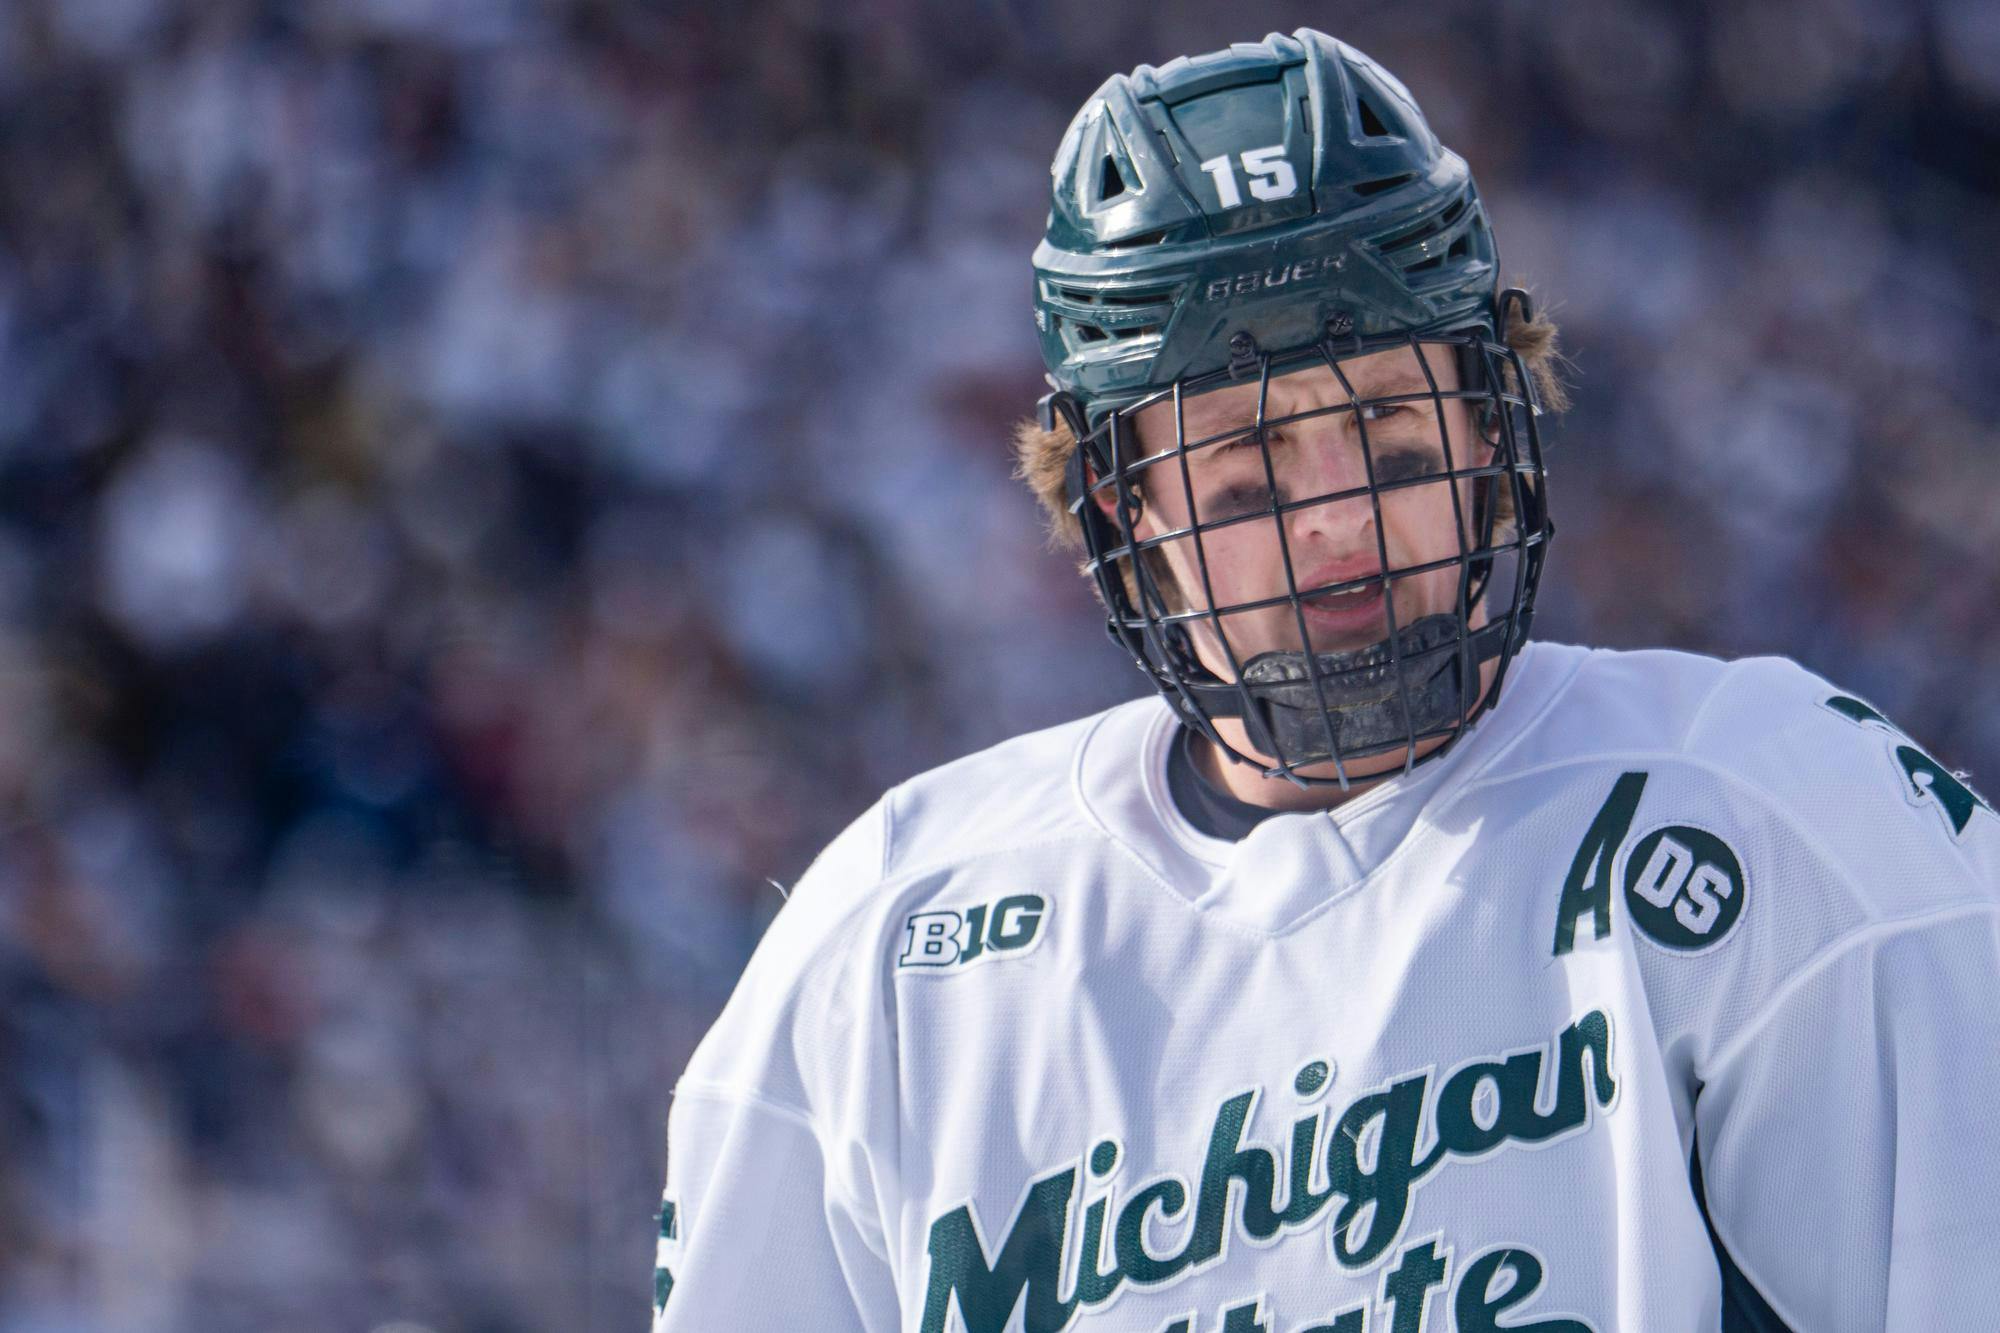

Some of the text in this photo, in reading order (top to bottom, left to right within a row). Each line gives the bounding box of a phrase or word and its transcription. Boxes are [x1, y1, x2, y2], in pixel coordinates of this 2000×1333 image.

[1200, 144, 1298, 209] 15
[1206, 253, 1348, 300] BAUER
[1552, 771, 1649, 956] A
[1632, 832, 1733, 935] DS
[918, 1008, 1619, 1333] Michigan
